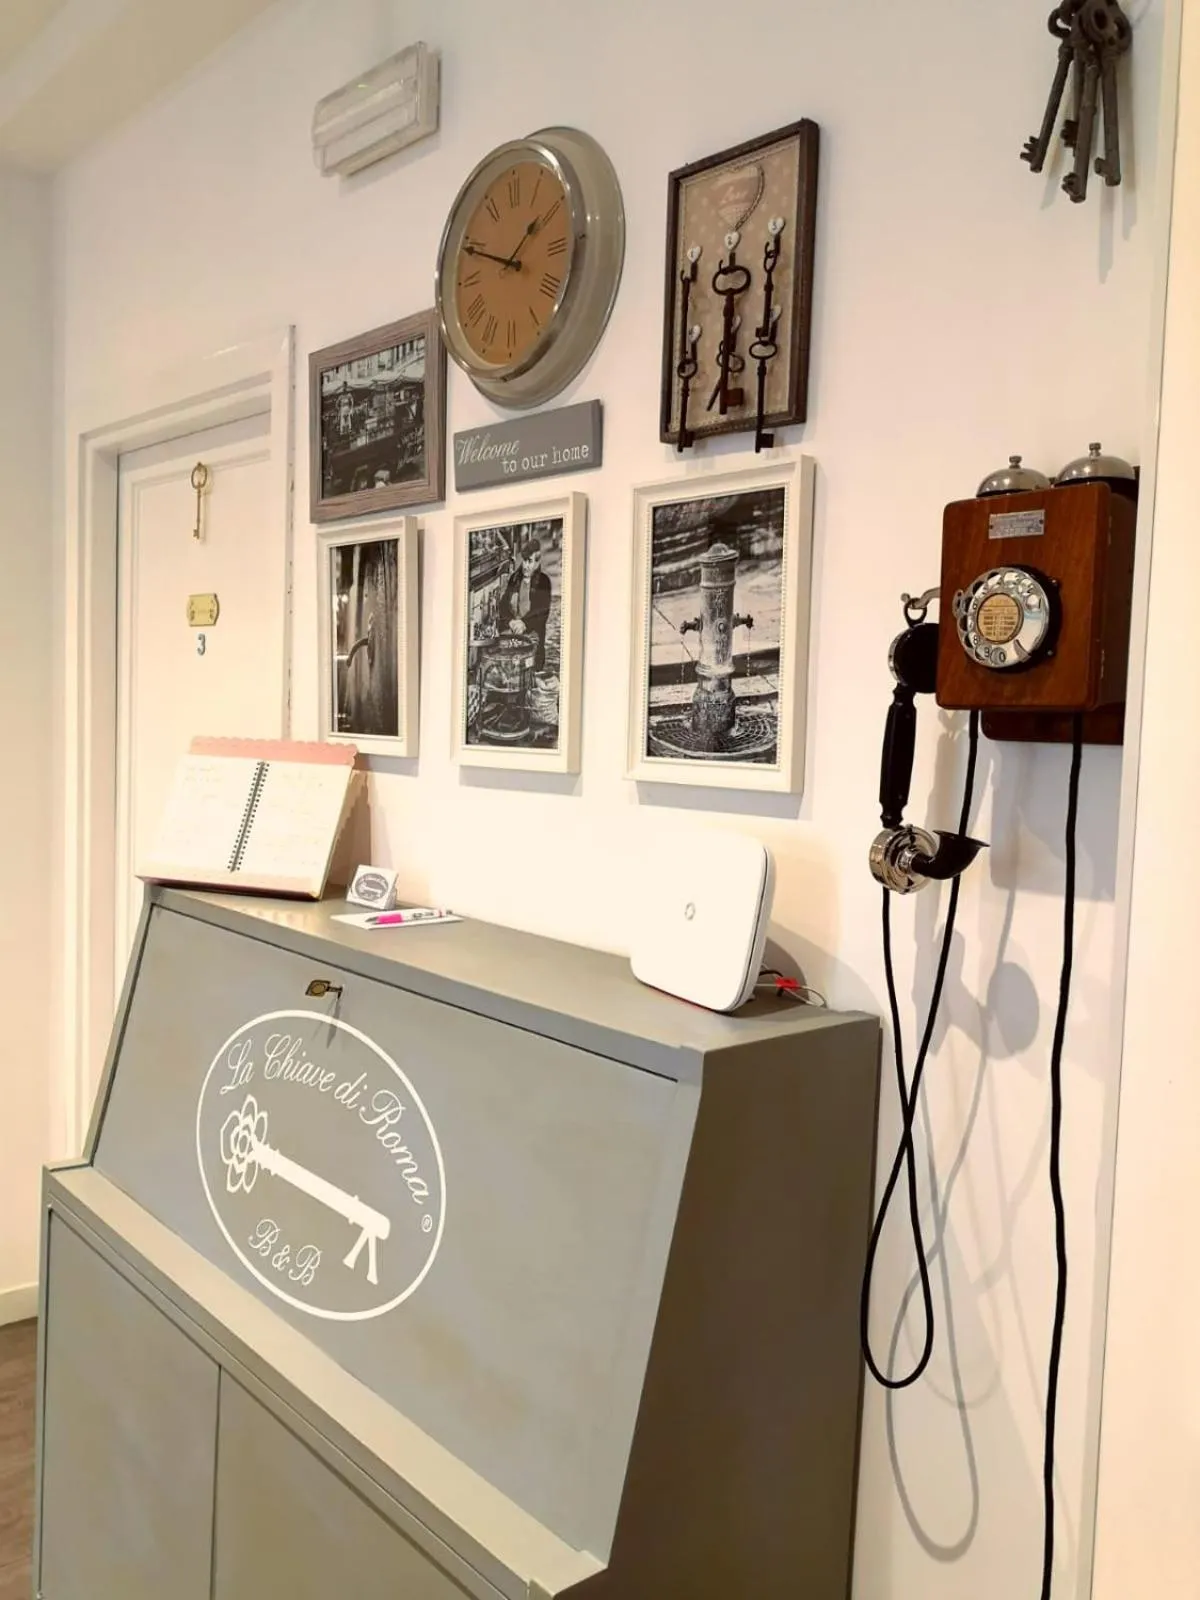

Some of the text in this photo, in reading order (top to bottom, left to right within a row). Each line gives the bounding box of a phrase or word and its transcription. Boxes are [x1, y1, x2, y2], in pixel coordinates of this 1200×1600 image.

[456, 433, 521, 467] Welcome
[501, 444, 589, 474] to our home
[196, 633, 206, 656] 3
[220, 1038, 255, 1095] La
[264, 1033, 336, 1093] Chiave
[334, 1072, 368, 1109] di
[359, 1089, 431, 1206] Roma
